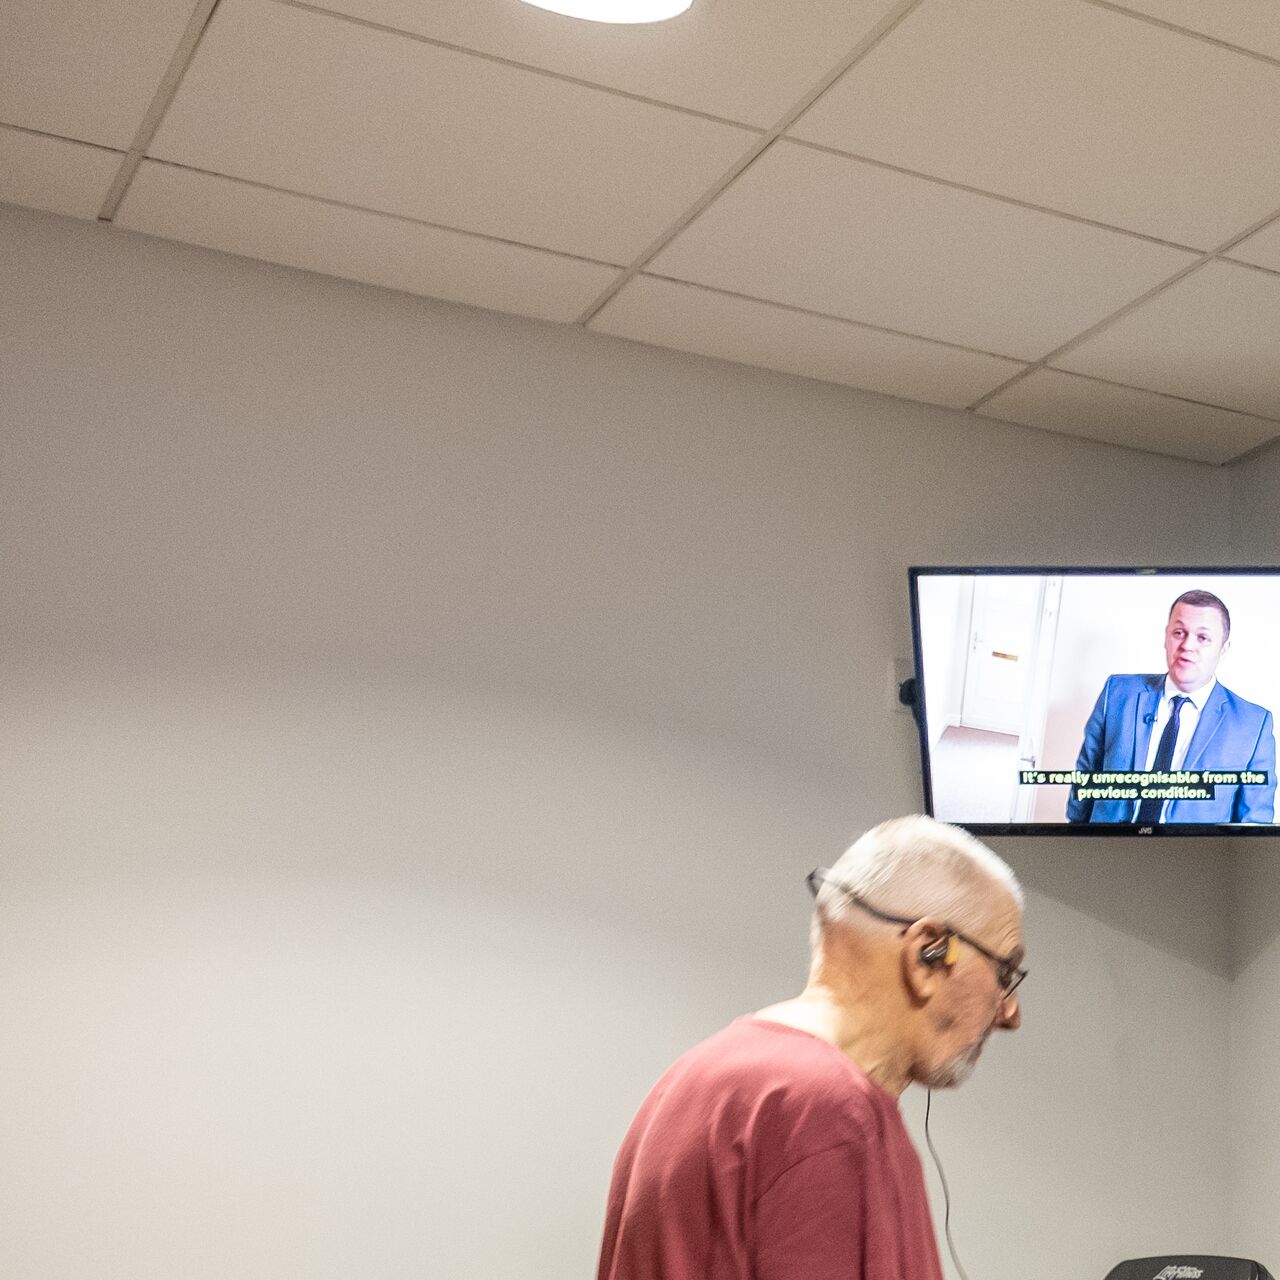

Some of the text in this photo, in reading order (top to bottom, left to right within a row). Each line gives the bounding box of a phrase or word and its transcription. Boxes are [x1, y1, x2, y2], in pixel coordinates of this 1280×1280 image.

[1022, 771, 1265, 787] It's really unrecognisable from the
[1077, 786, 1211, 800] previous condition.
